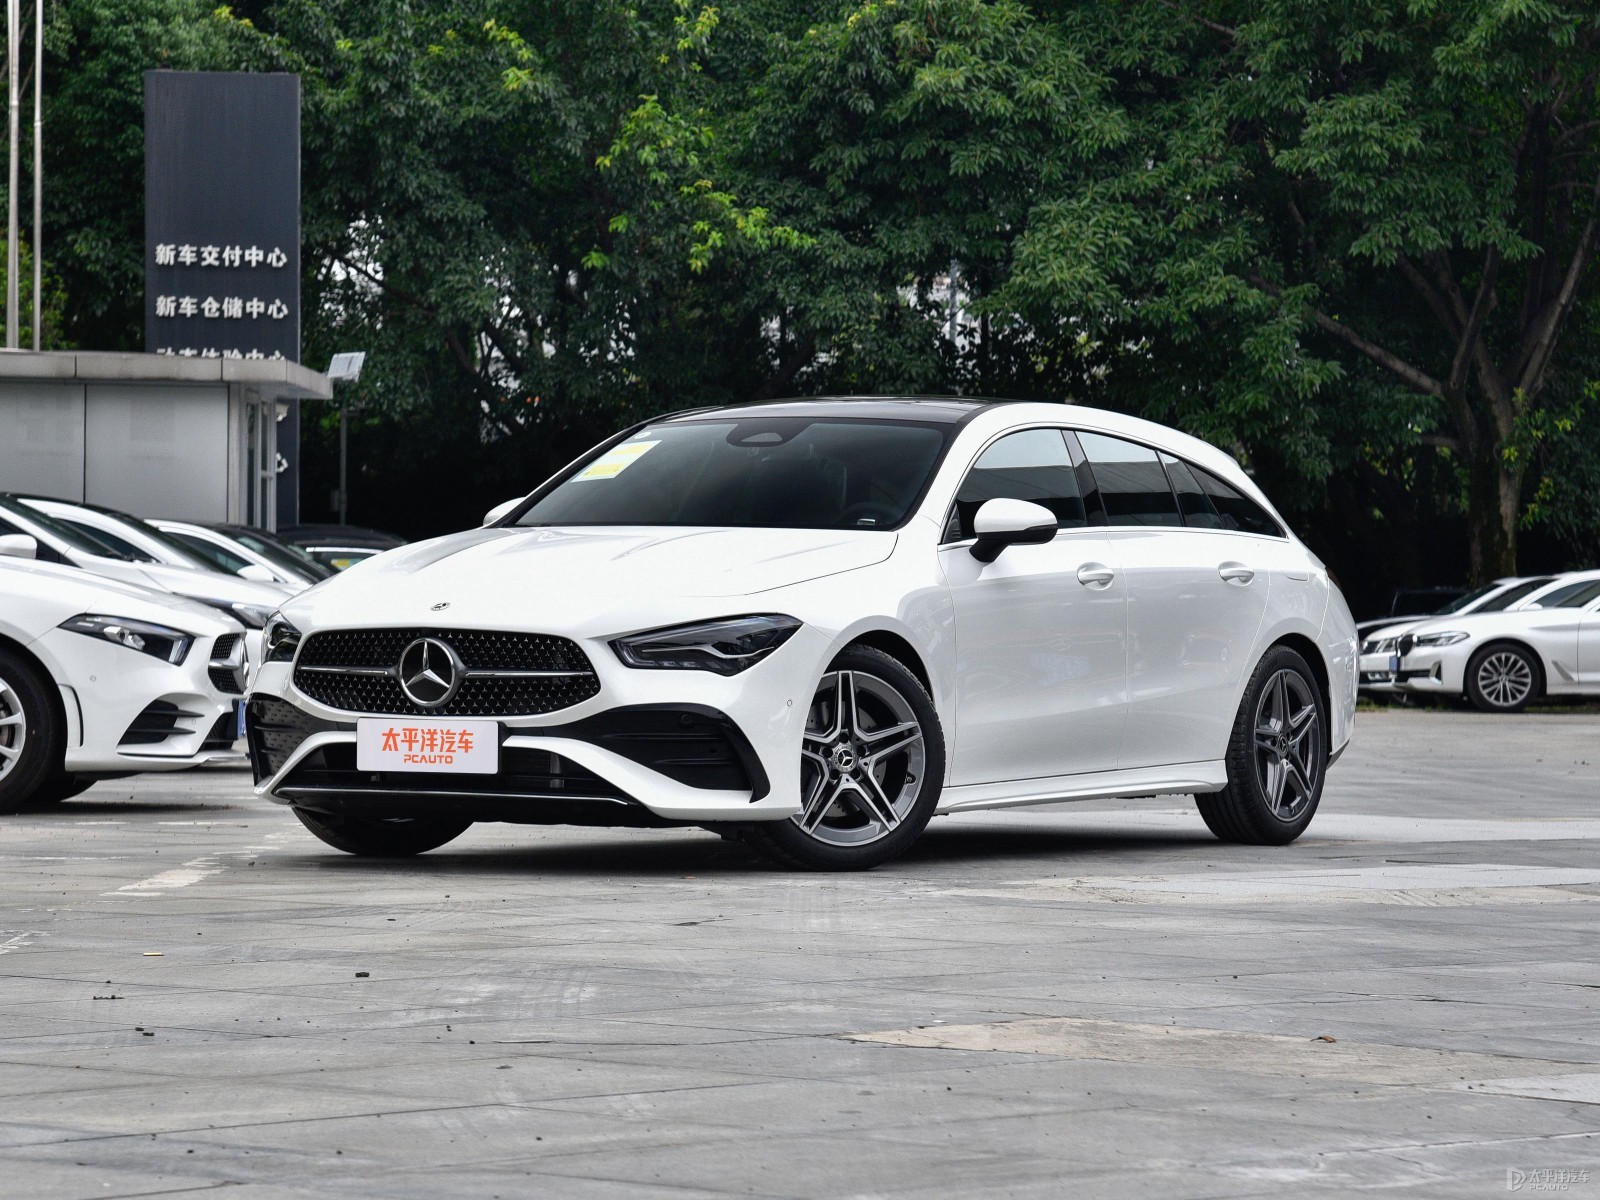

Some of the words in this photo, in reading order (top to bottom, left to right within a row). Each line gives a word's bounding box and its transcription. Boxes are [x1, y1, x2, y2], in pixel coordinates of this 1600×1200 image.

[156, 243, 288, 267] 新车交付中心
[155, 295, 289, 319] 新车仓储中心
[382, 727, 474, 753] 太平洋汽车
[403, 754, 453, 764] PCAUTO
